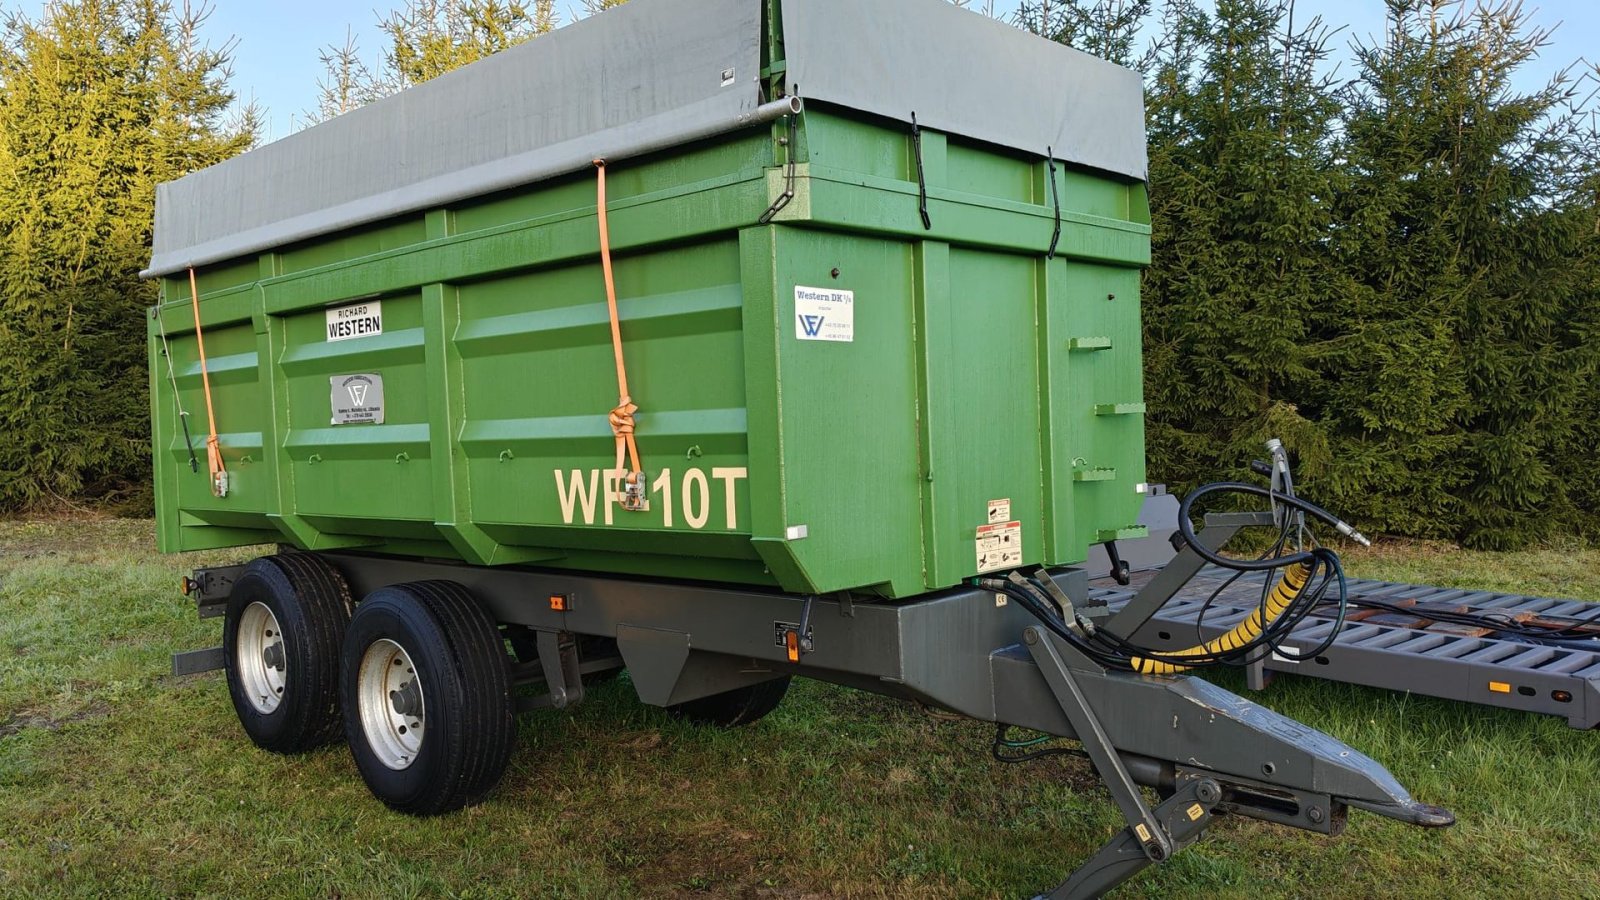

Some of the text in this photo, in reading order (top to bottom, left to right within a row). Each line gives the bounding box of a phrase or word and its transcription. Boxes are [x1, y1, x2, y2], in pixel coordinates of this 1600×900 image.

[797, 290, 830, 302] Western
[831, 293, 843, 303] DK
[338, 306, 368, 319] RICHARD
[328, 315, 380, 338] WESTERN
